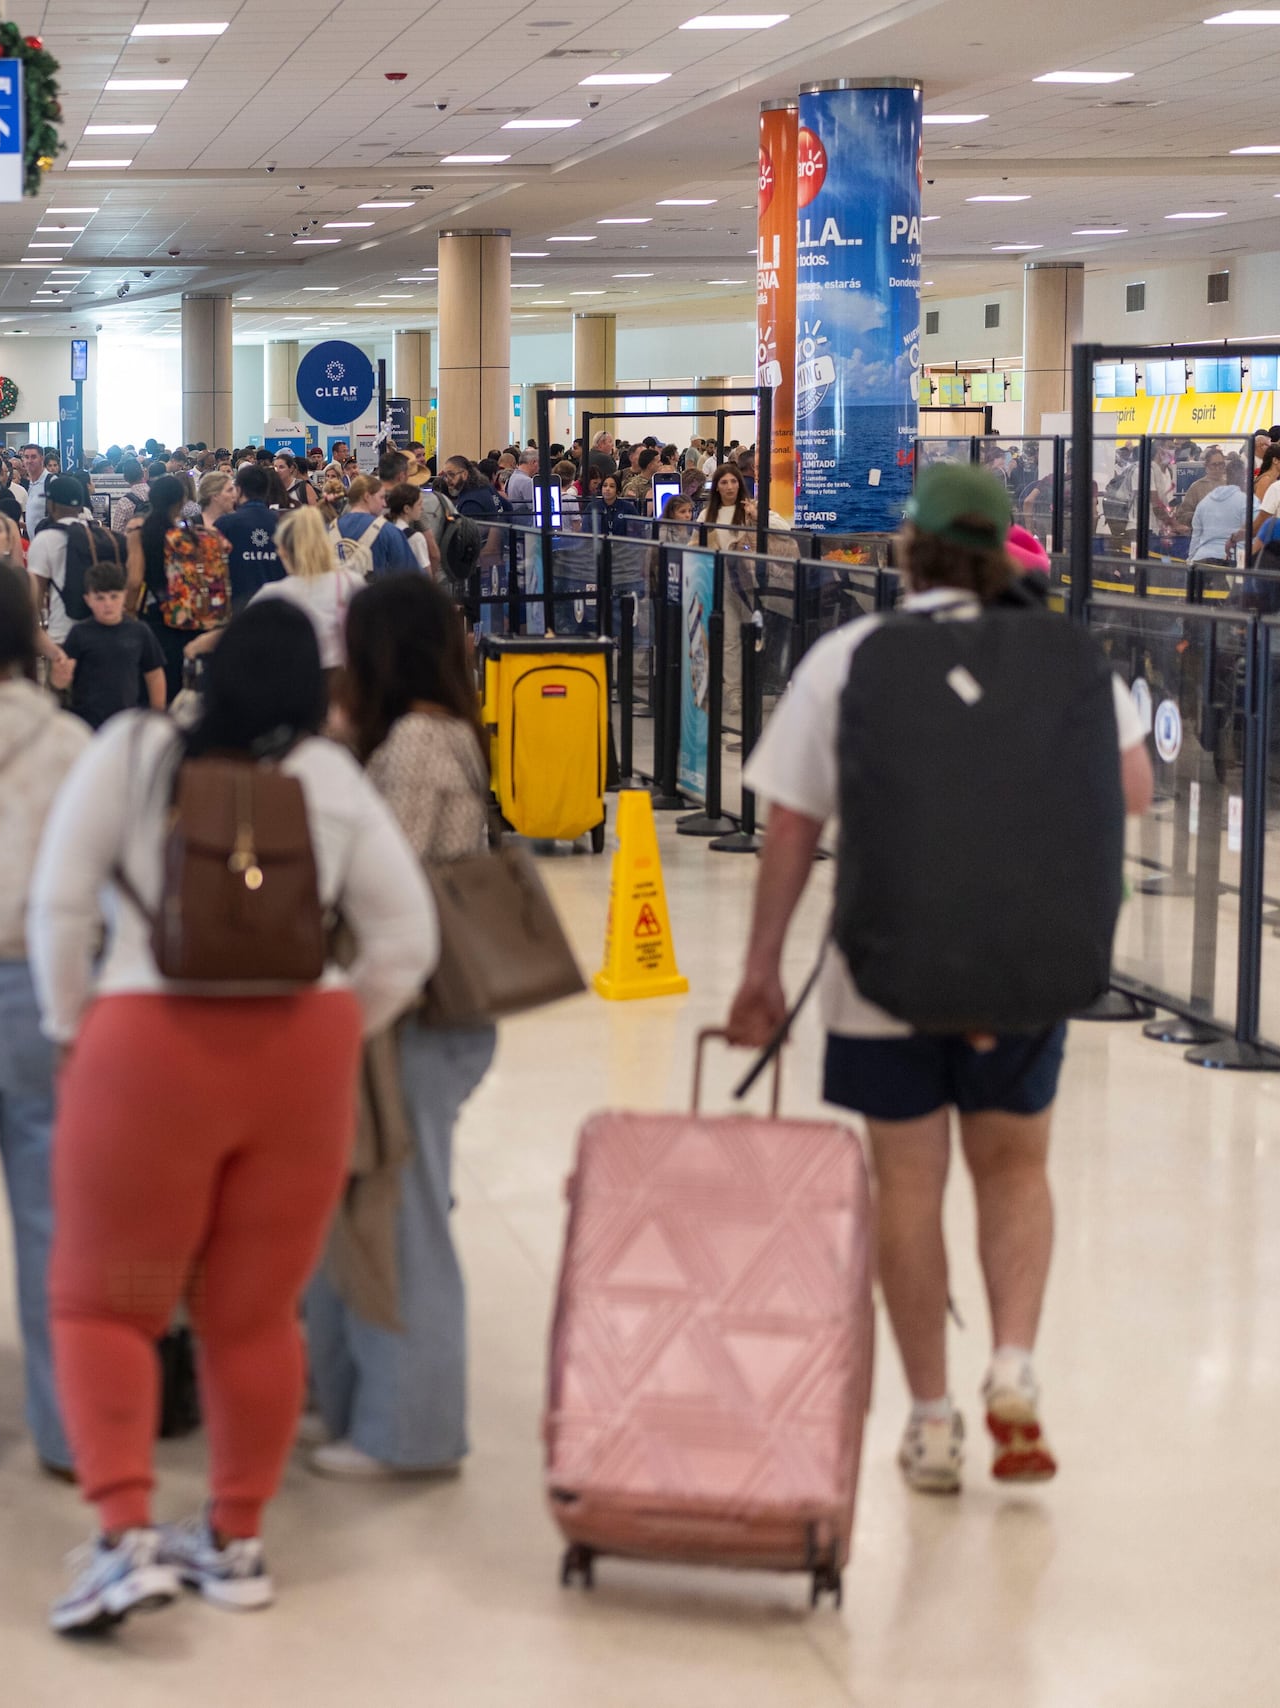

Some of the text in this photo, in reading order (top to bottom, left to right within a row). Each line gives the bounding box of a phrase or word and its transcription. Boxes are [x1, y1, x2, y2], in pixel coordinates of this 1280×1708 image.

[824, 278, 861, 289] estarás
[315, 386, 357, 397] CLEAR
[1191, 405, 1216, 424] spirit
[66, 434, 75, 471] TSA
[803, 511, 837, 521] GRATIS
[242, 551, 278, 560] CLEAR
[481, 587, 507, 597] EAR
